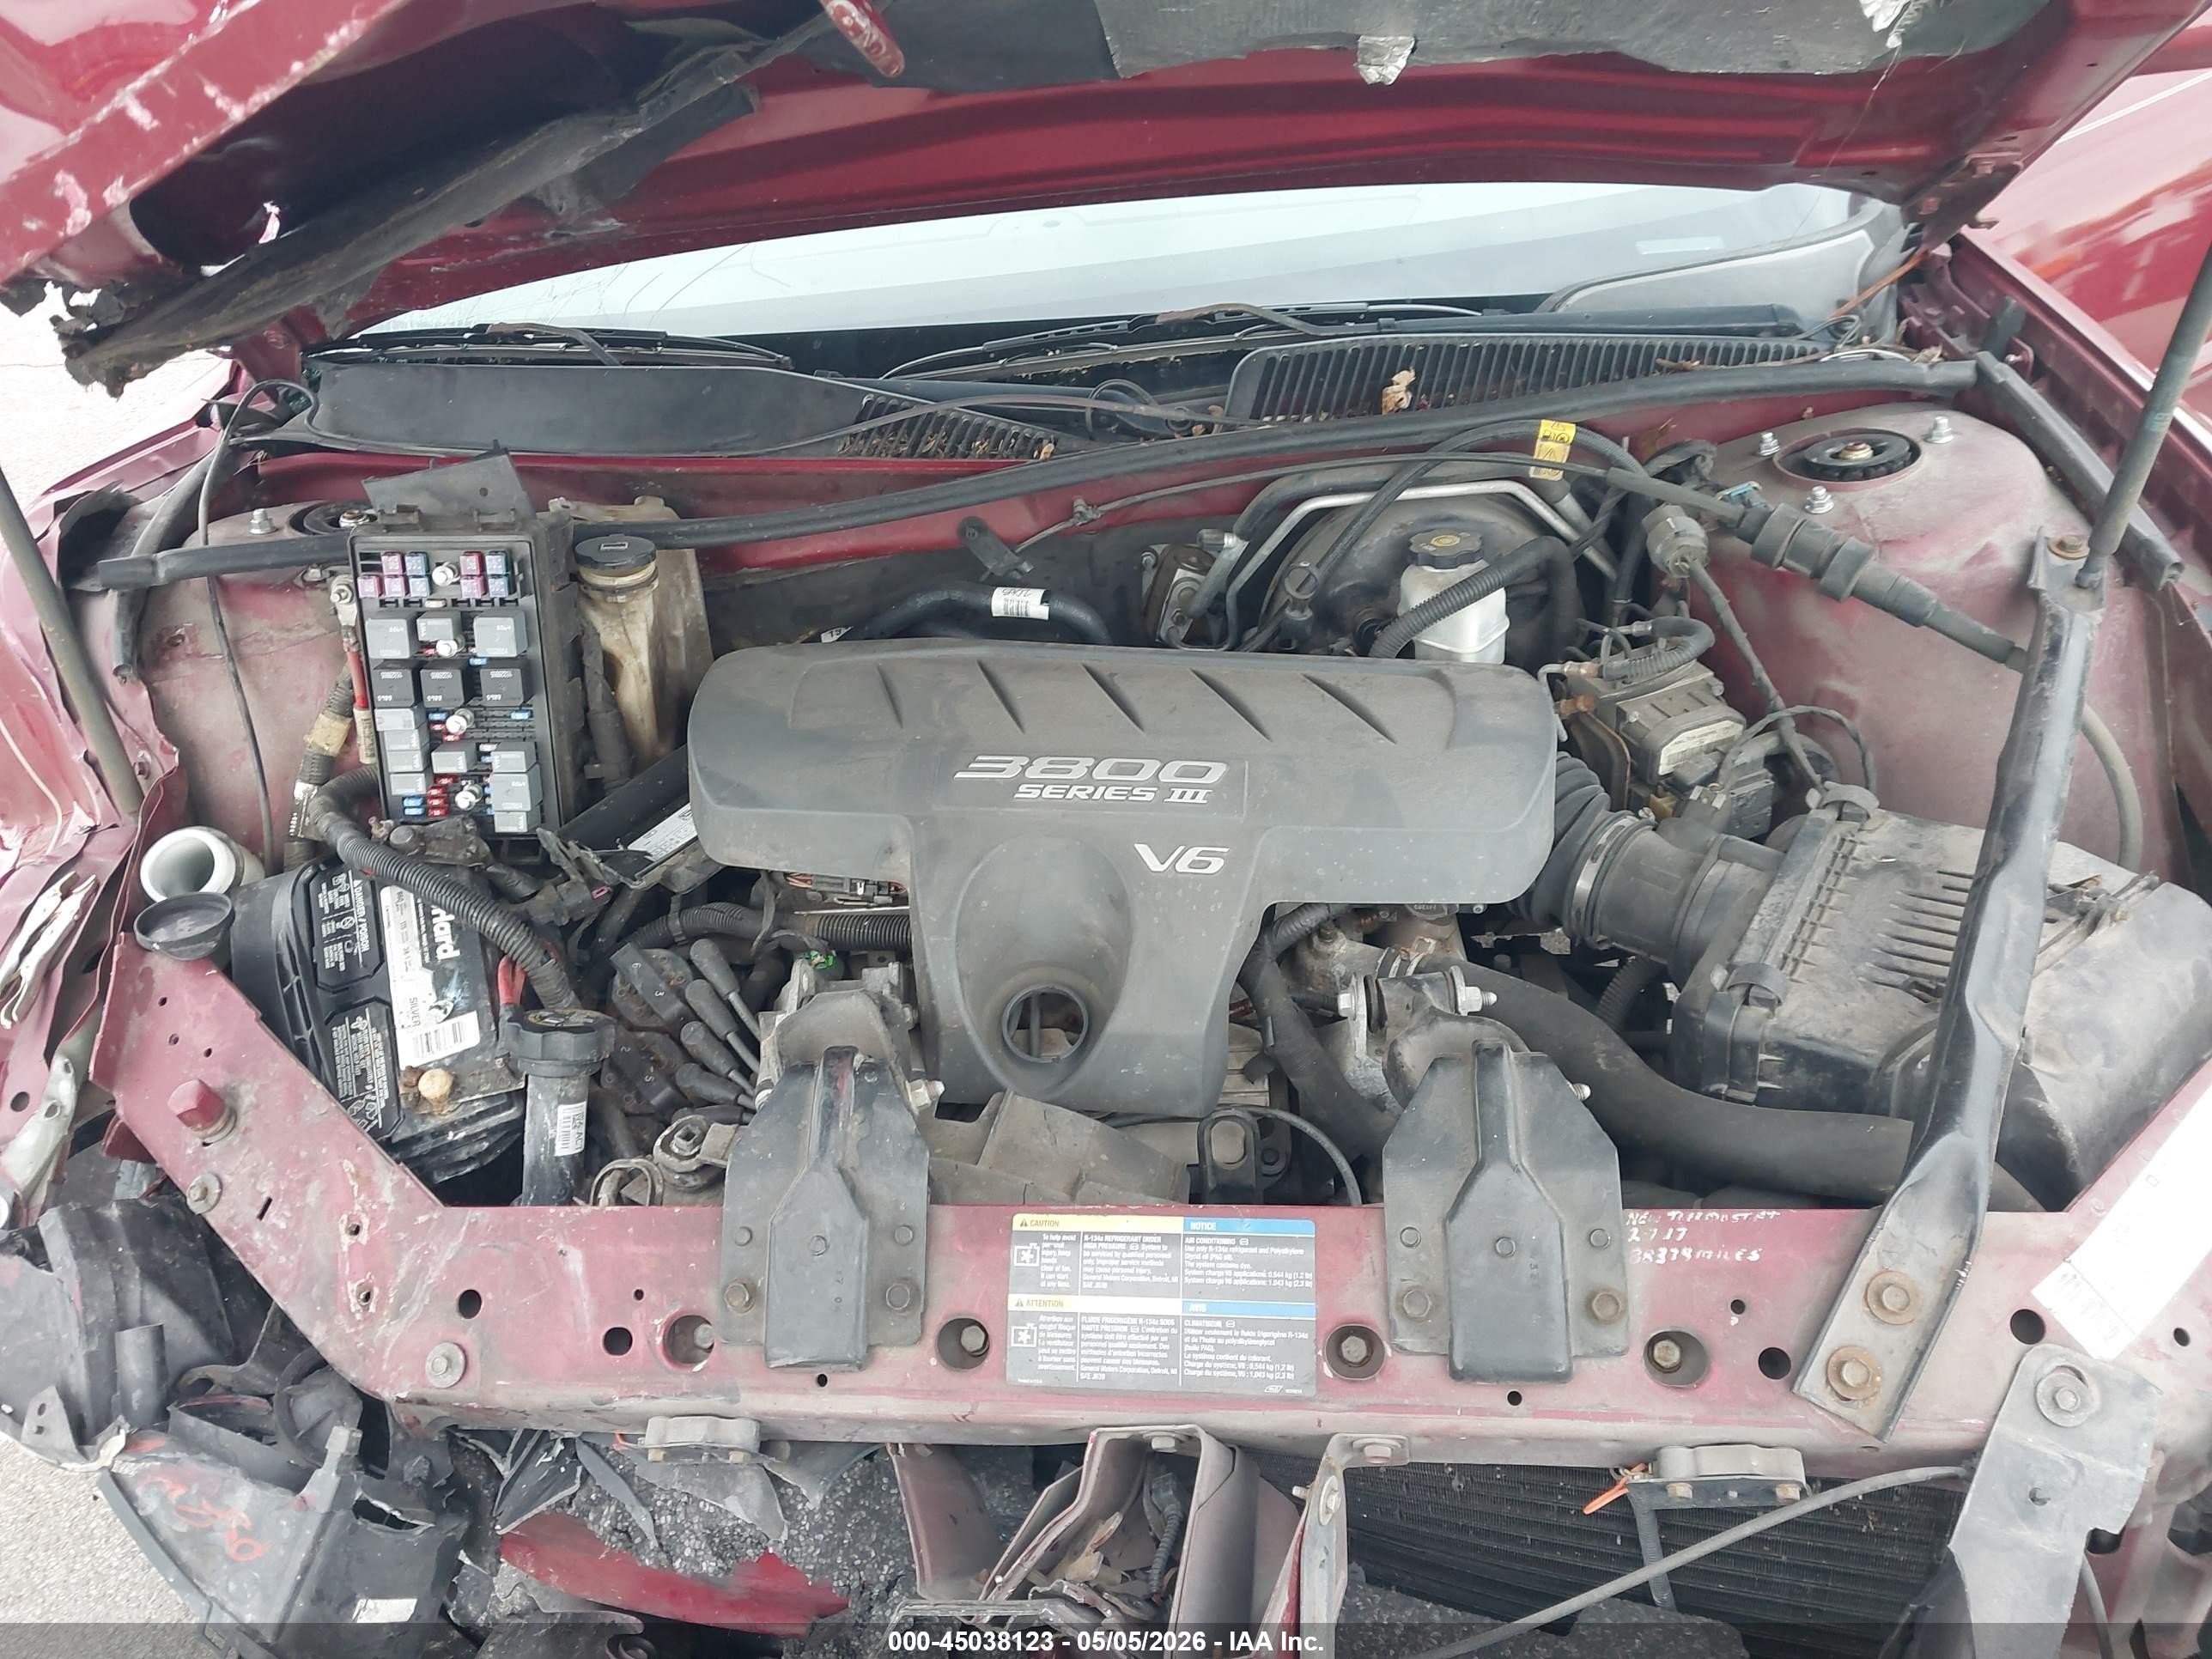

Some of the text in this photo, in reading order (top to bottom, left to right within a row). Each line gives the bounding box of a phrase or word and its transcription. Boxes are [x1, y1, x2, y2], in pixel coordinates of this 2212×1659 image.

[953, 755, 1228, 784] 3800
[1013, 784, 1212, 804] SERIES III
[1133, 843, 1231, 874] V6
[354, 886, 366, 917] DANGER
[359, 922, 370, 953] POISON
[409, 997, 422, 1028] SILVER
[1030, 1219, 1060, 1228] CAUTION
[1190, 1222, 1216, 1231] NOTICE
[1026, 1298, 1064, 1308] ATTENTION
